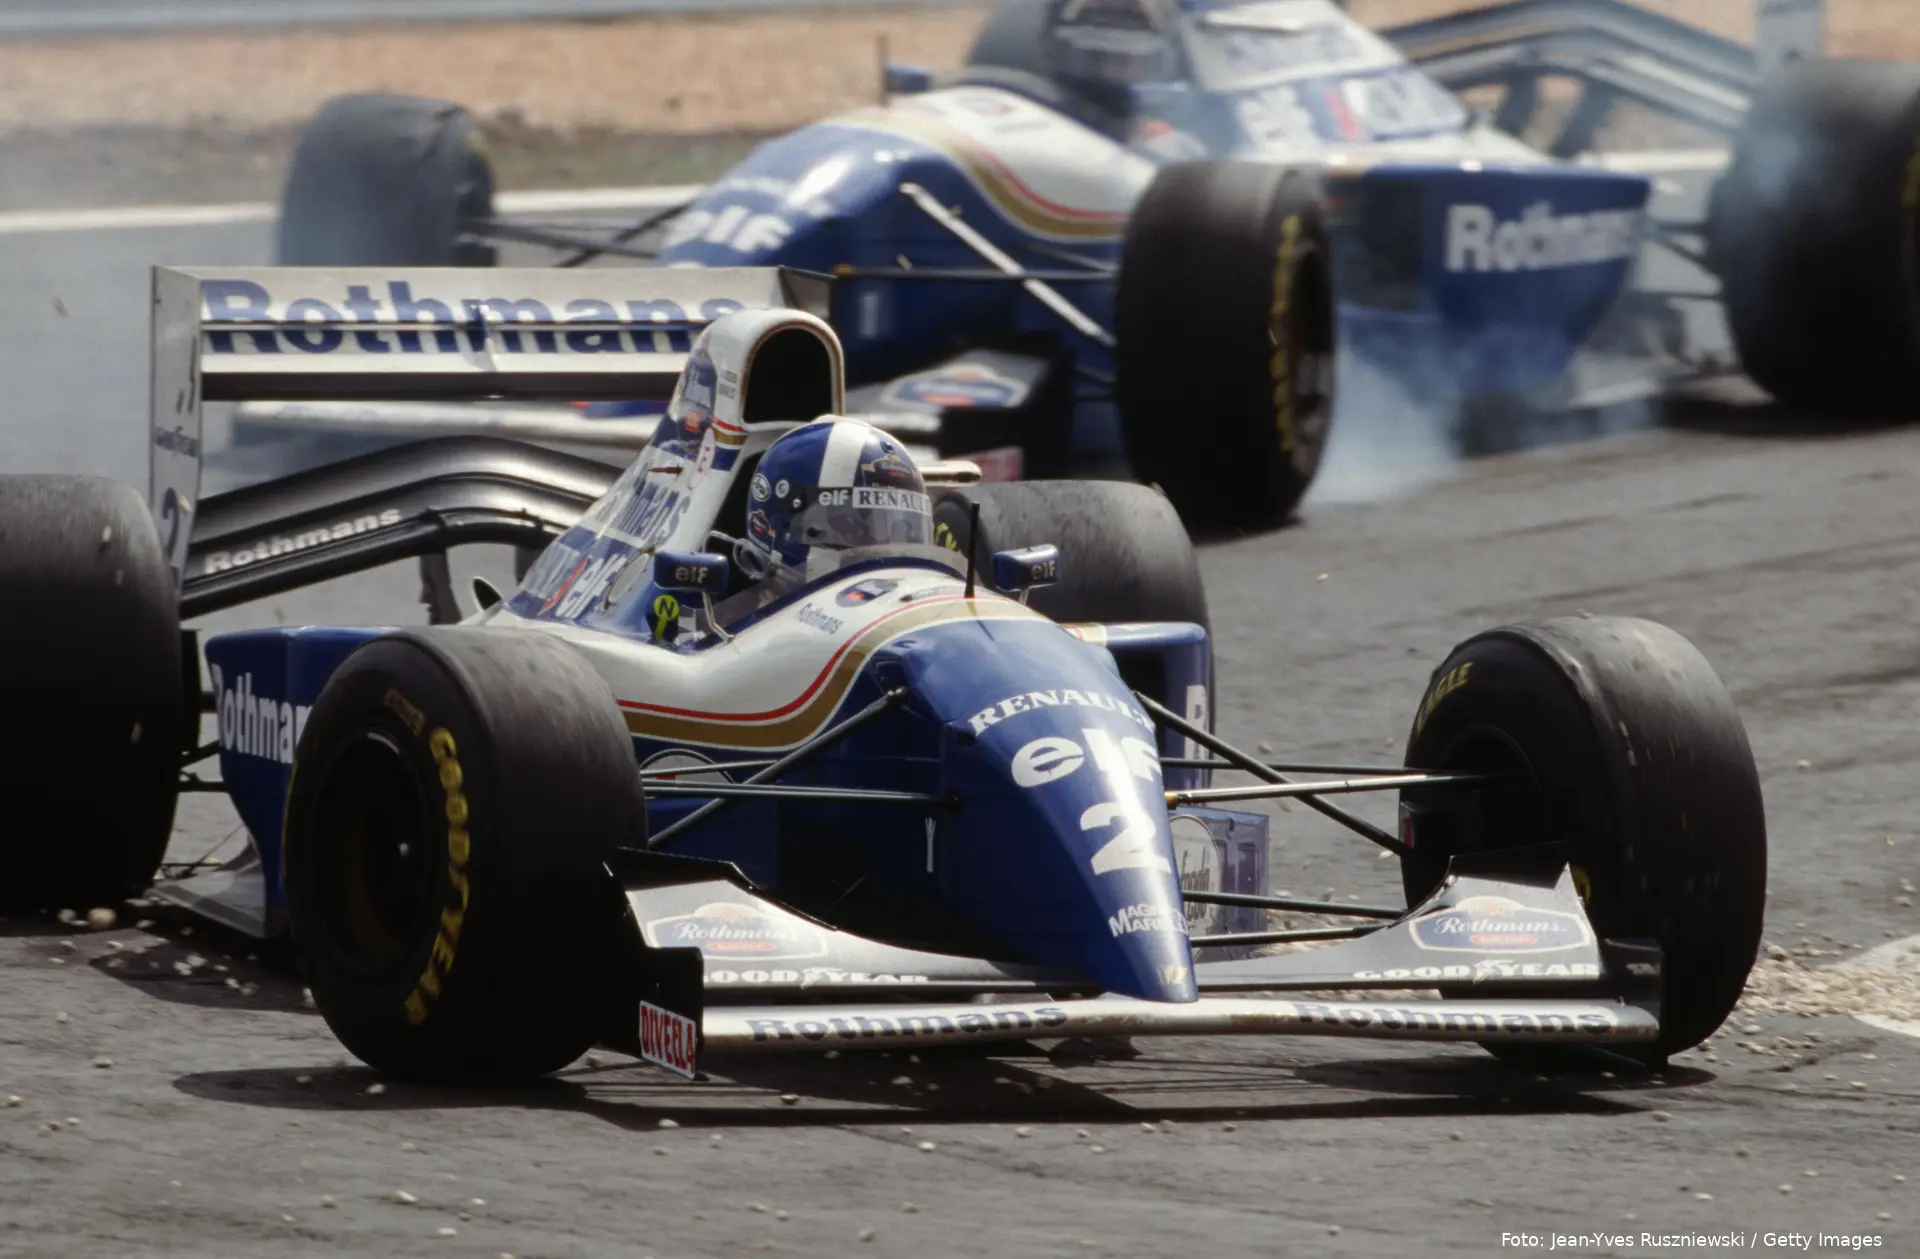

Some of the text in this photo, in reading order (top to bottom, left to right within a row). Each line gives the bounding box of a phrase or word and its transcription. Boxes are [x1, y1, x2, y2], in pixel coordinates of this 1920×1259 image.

[818, 489, 849, 506] elf
[204, 508, 402, 574] Rothmans
[675, 566, 709, 584] elf
[1032, 564, 1056, 584] elf
[1011, 728, 1163, 790] elf
[1080, 801, 1173, 876] 2
[745, 1004, 1070, 1042] Rothmans
[1295, 1002, 1613, 1033] Rothmans
[640, 1005, 695, 1074] DIVELLA
